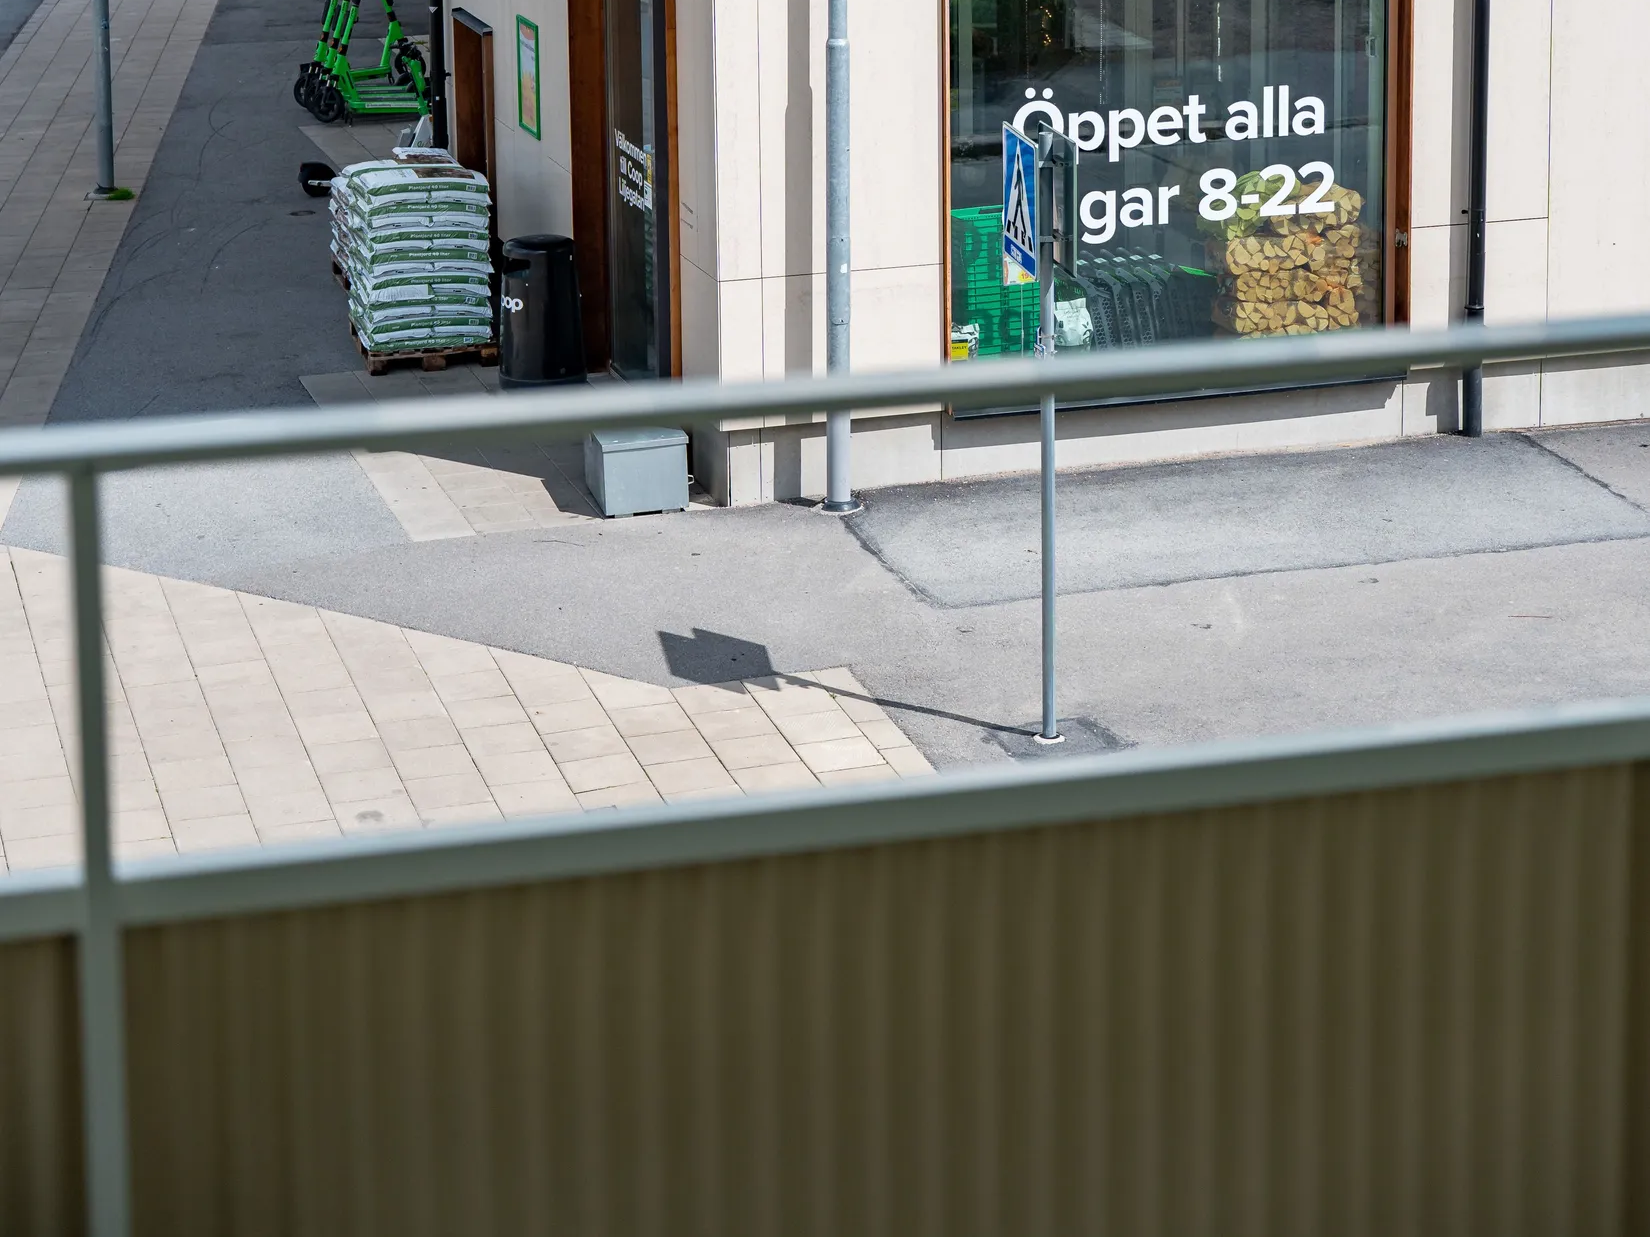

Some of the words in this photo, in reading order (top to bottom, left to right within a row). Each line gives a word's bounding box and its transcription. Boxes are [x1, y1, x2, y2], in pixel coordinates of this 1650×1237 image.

[1012, 87, 1206, 164] Öppet
[1225, 85, 1326, 140] alla
[627, 161, 643, 190] Coop
[1079, 185, 1180, 244] gar
[1198, 161, 1336, 222] 8-22
[501, 294, 524, 313] oop
